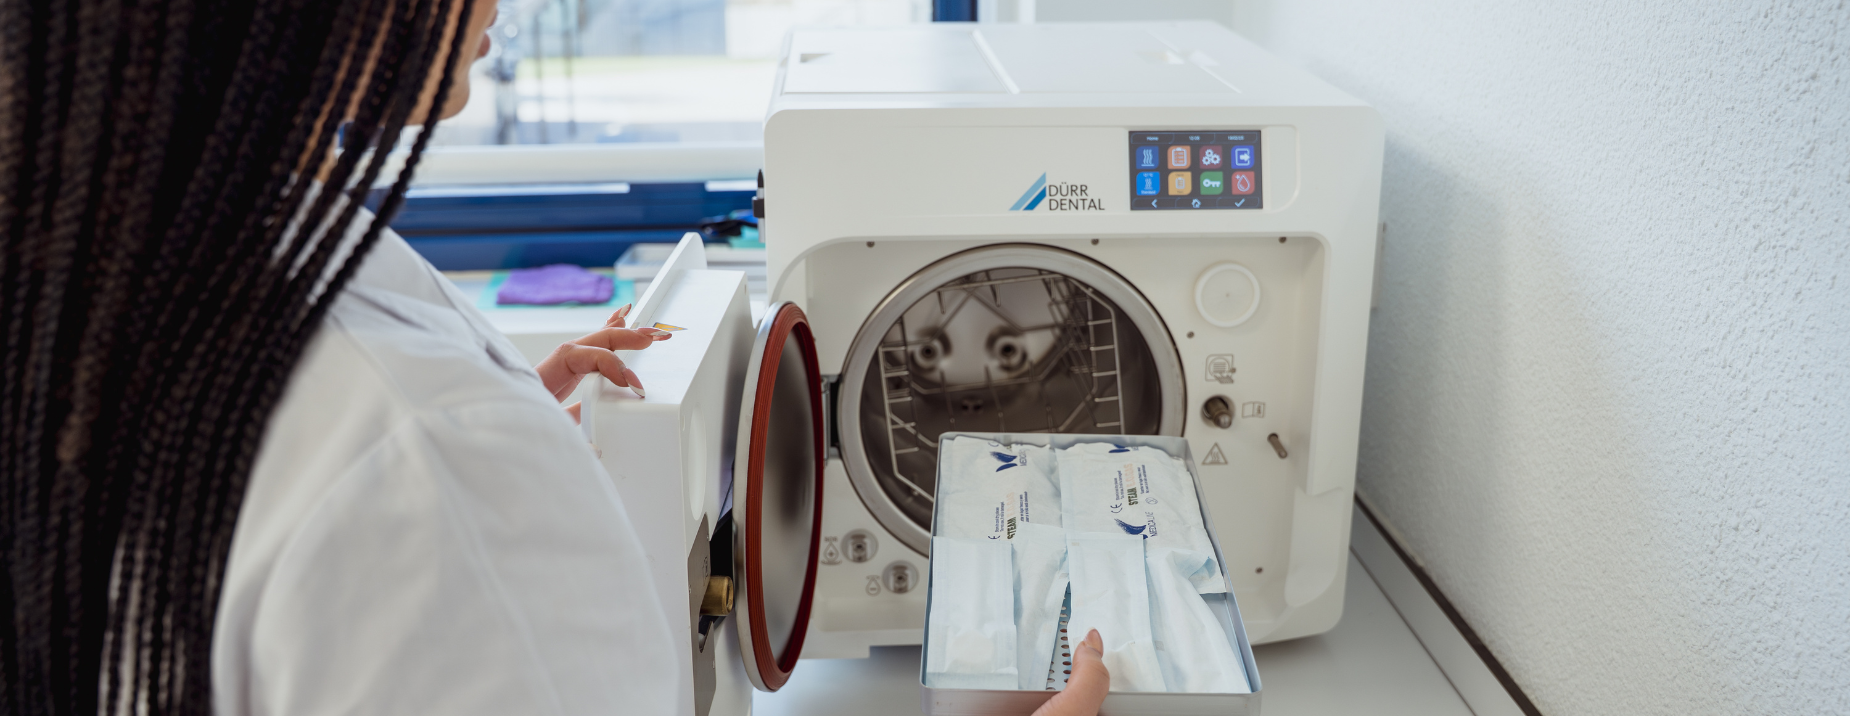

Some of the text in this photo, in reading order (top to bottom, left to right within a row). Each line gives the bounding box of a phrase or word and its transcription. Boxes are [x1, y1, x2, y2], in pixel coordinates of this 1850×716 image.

[1048, 182, 1088, 197] DÜRR
[1048, 198, 1105, 211] DENTAL
[1126, 487, 1139, 506] STEAM
